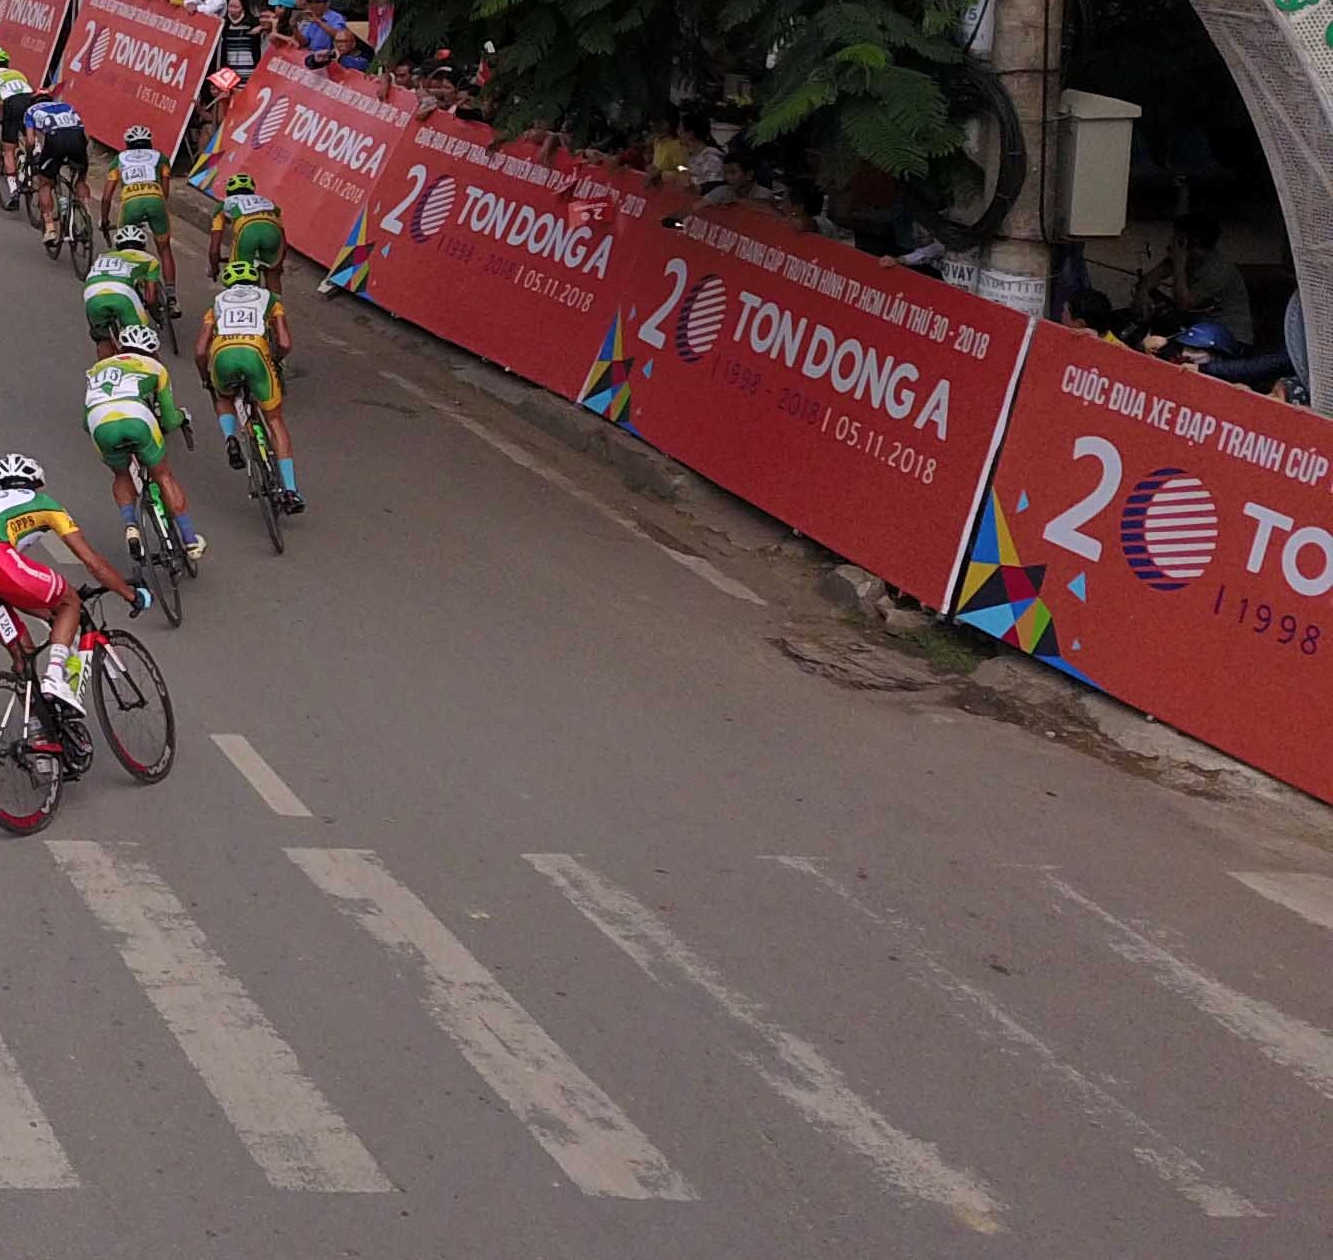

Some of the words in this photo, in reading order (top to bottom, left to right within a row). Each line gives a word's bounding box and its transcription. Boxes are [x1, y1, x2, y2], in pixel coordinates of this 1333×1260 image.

[284, 104, 326, 147] TON
[314, 121, 373, 170] DONG
[361, 144, 386, 179] A
[457, 185, 517, 237] TON
[507, 207, 592, 268] DONG
[583, 235, 613, 279] A
[228, 310, 255, 324] 124
[953, 325, 990, 360] 2018
[733, 290, 809, 368] TON
[801, 324, 921, 420] DONG
[913, 379, 951, 442] A
[835, 417, 938, 486] 05.11.2018
[1061, 365, 1109, 407] CUỘC
[1108, 384, 1147, 420] ĐUA
[1147, 397, 1172, 432] XE
[1175, 405, 1217, 446] ĐẠP
[1217, 420, 1285, 472] TRANH
[1285, 445, 1329, 486] CÚP
[1237, 597, 1323, 656] 1998
